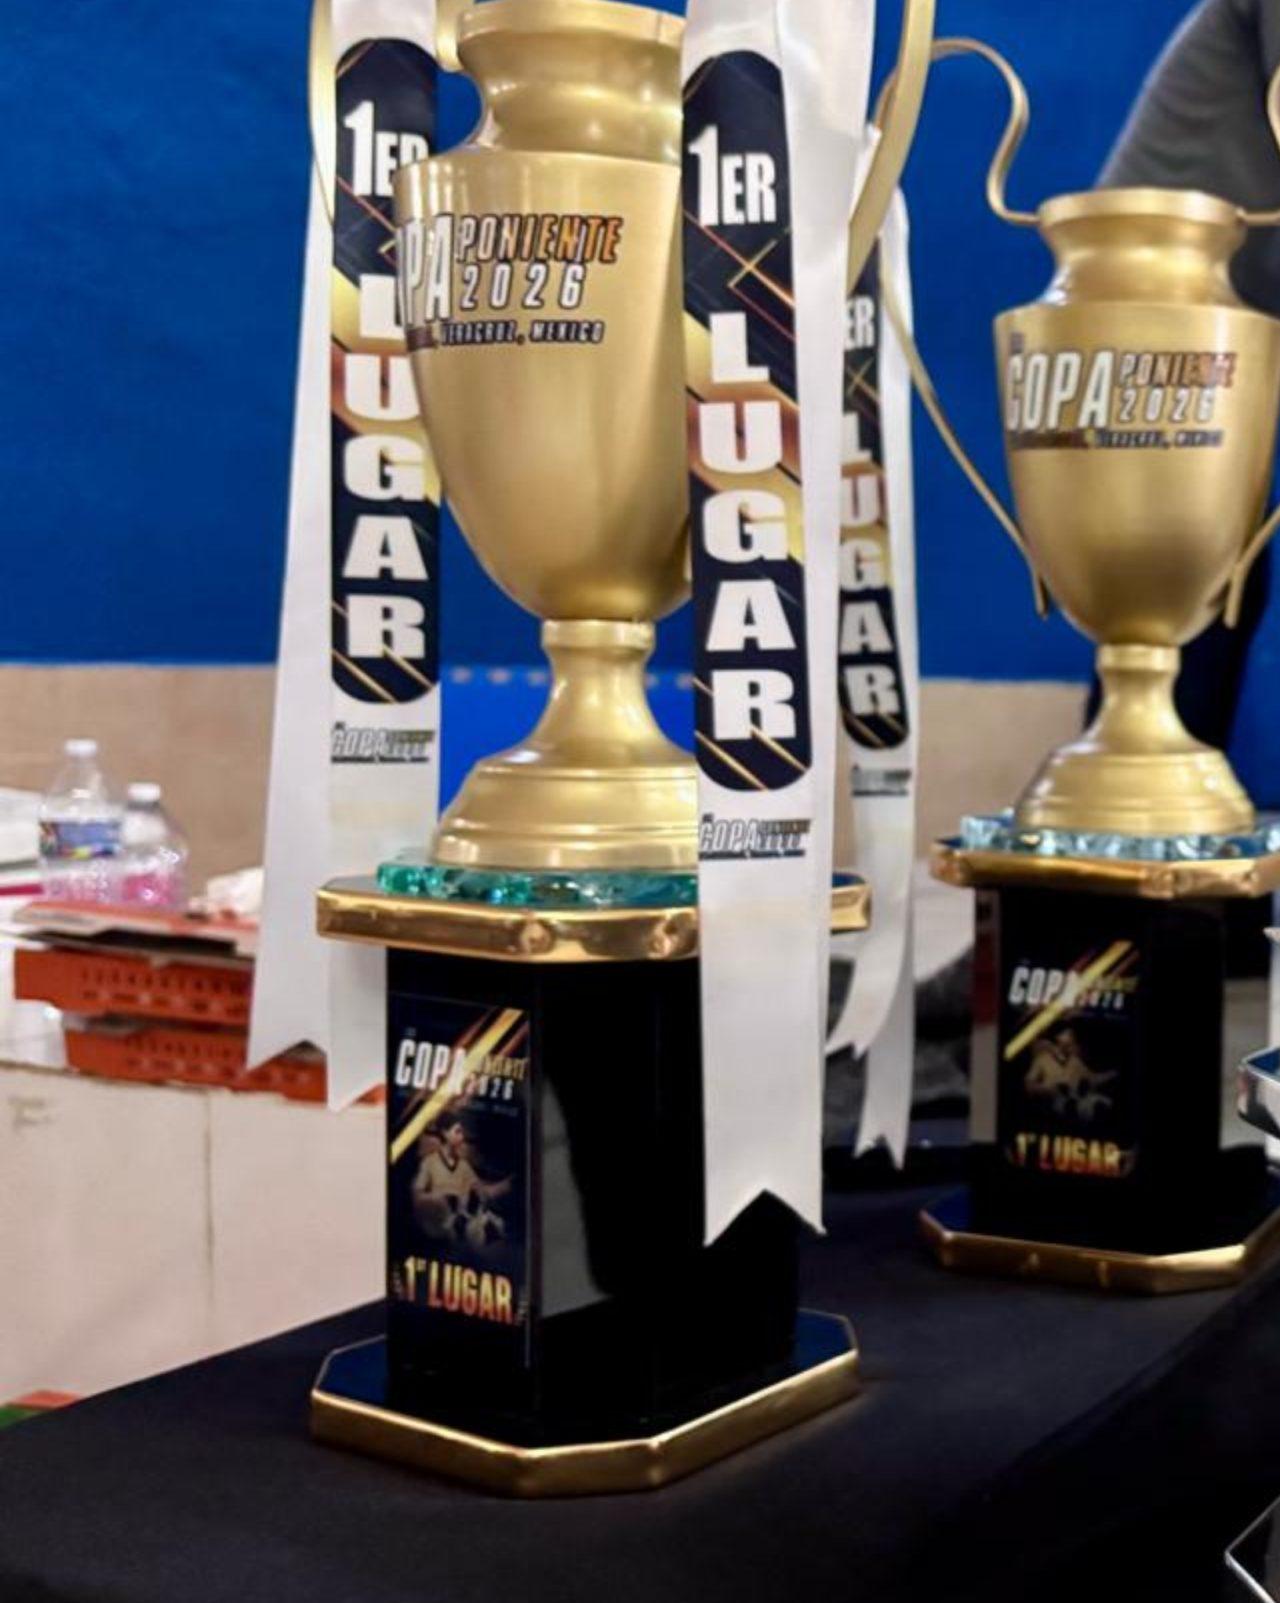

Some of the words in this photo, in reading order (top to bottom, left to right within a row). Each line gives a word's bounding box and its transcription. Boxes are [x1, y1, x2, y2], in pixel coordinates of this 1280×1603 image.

[688, 126, 777, 226] 1ER
[456, 214, 623, 263] PONIENTE
[459, 260, 586, 311] 2026
[1005, 350, 1116, 433] COPA
[342, 273, 428, 659] LUGAR
[697, 311, 798, 741] LUGAR
[426, 1259, 514, 1325] LUGAR
